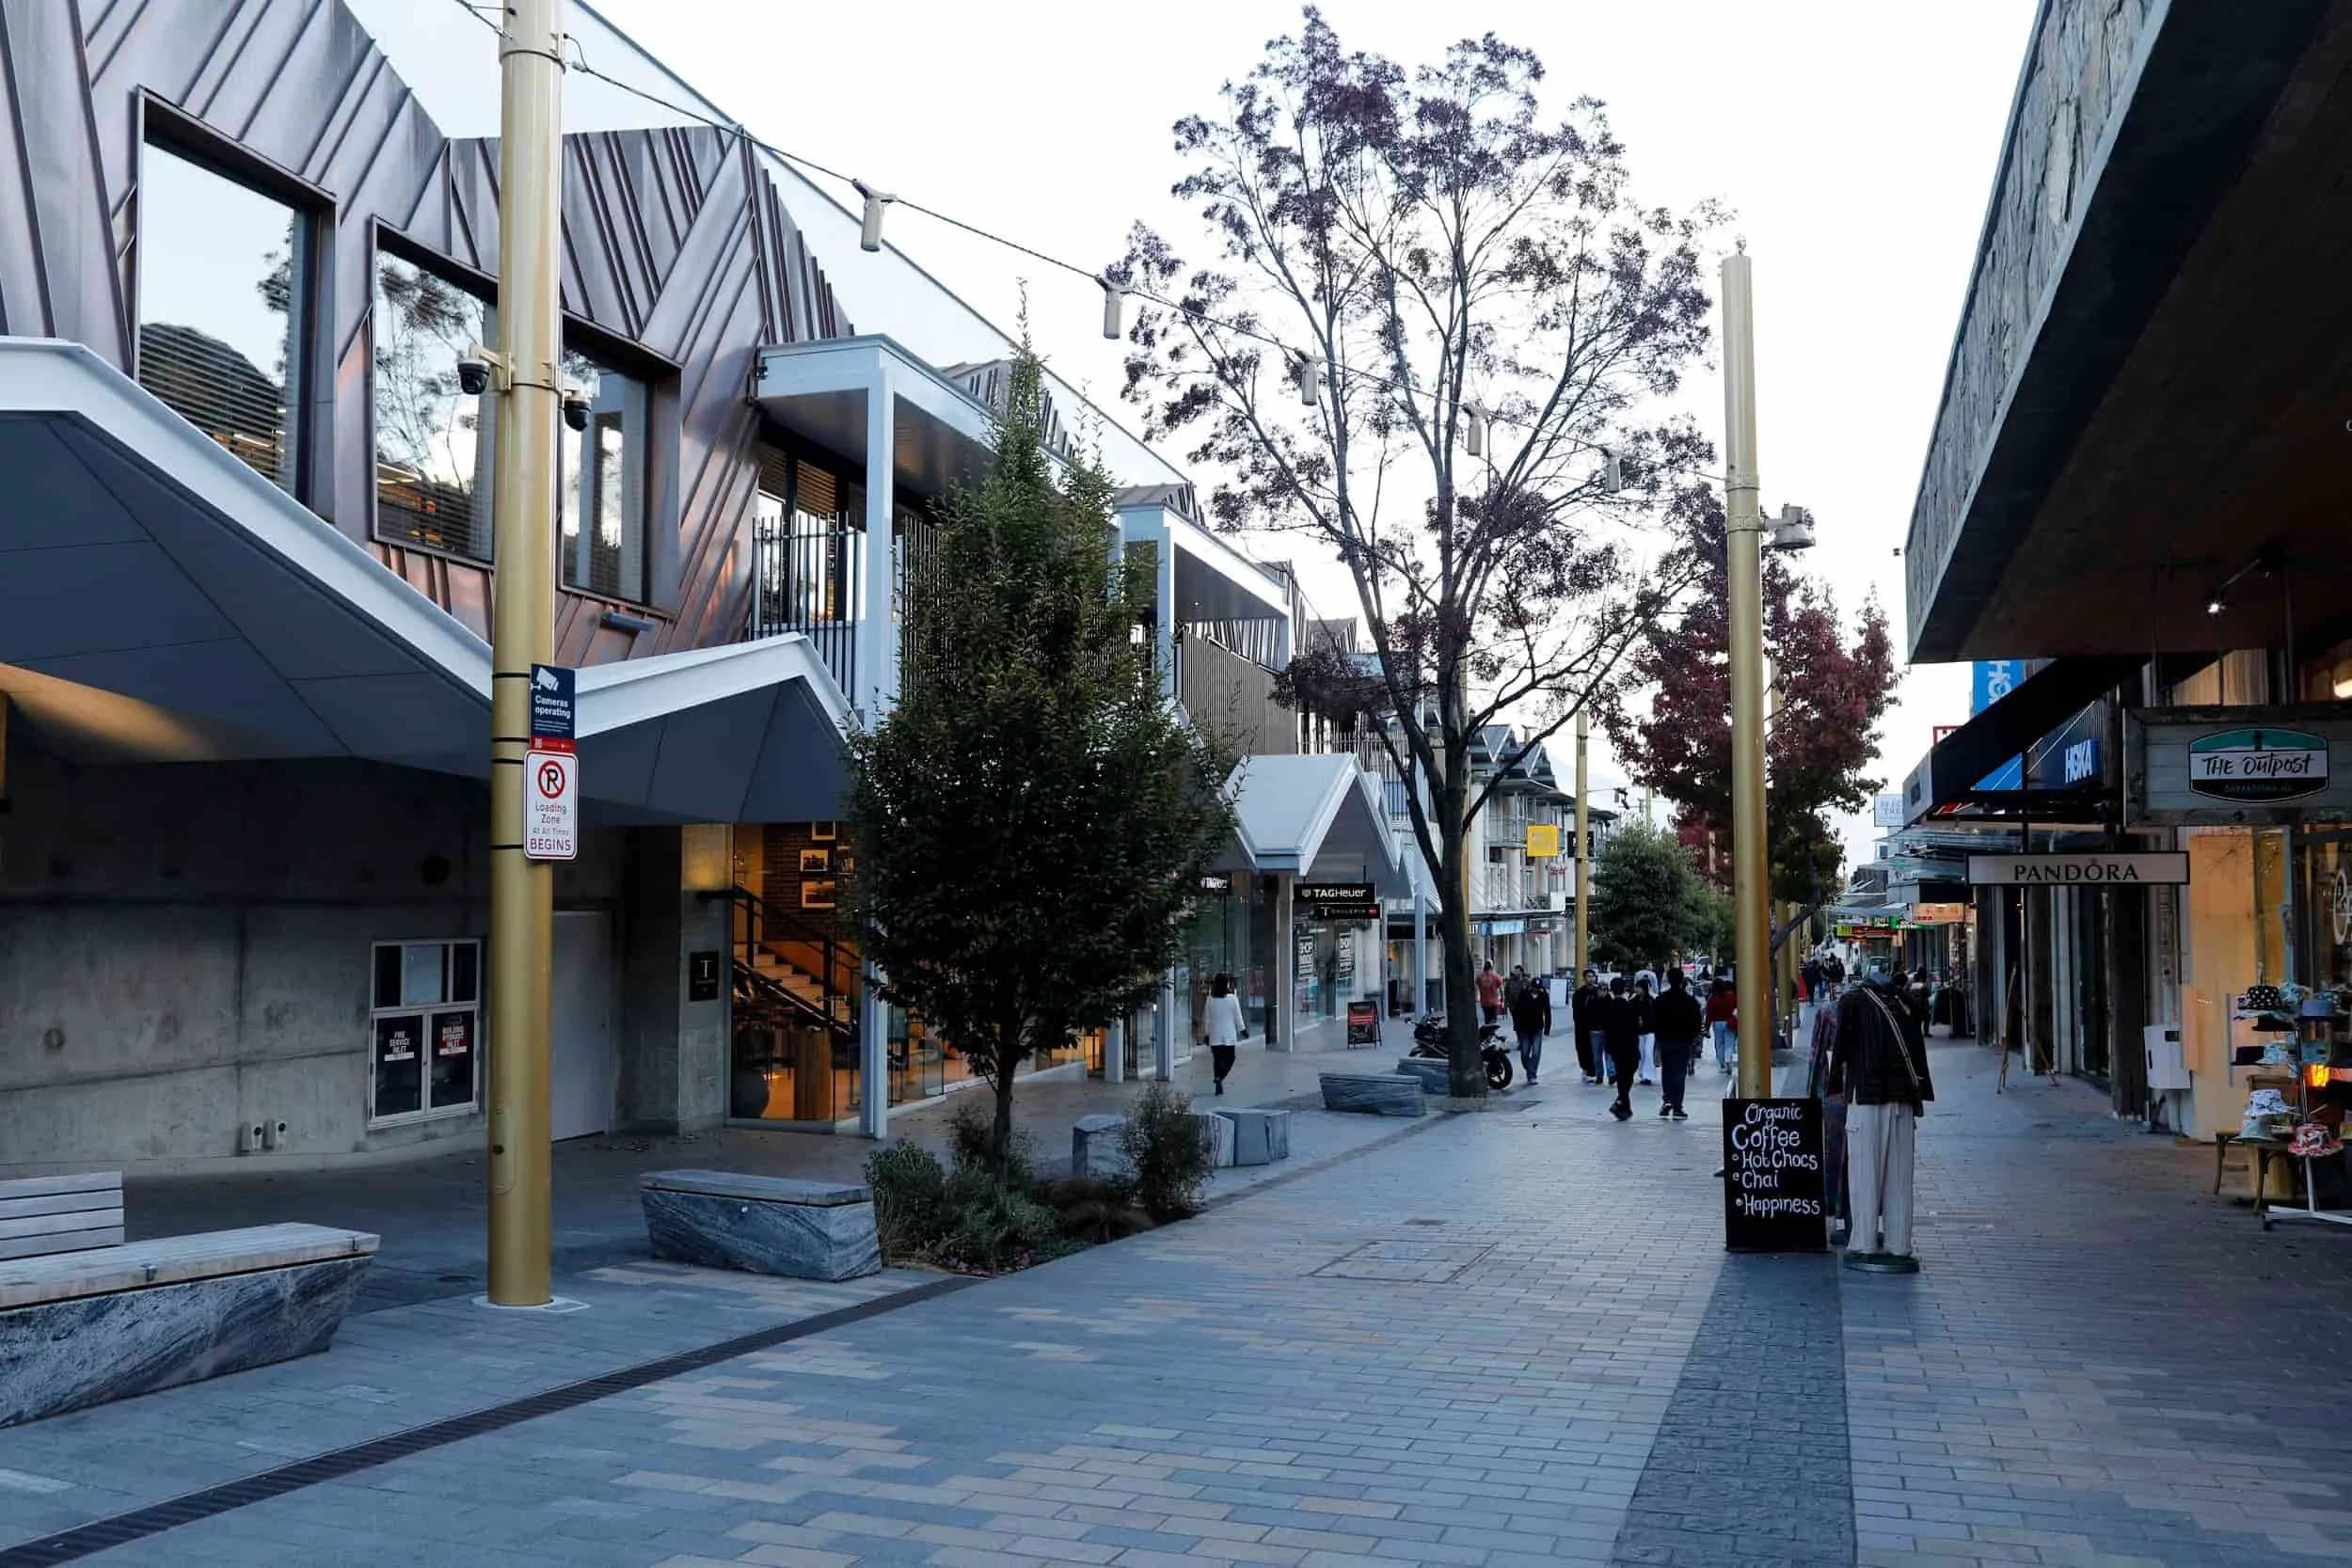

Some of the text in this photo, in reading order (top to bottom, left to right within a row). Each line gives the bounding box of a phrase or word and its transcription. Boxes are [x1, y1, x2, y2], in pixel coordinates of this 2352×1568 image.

[534, 695, 568, 707] Cameras
[534, 706, 571, 719] operating
[2065, 739, 2093, 784] HOKA
[2202, 755, 2234, 776] THE
[535, 800, 566, 815] Loading
[541, 814, 561, 825] Zone
[530, 838, 571, 850] BEGINS
[2014, 863, 2138, 881] PANDORA
[389, 1037, 410, 1047] SERVICE
[1745, 1102, 1803, 1127] Organic
[1732, 1124, 1801, 1150] Coffee
[1742, 1148, 1818, 1170] Hot Chocs
[1742, 1169, 1779, 1189] Chai
[1743, 1193, 1820, 1219] Happiness
